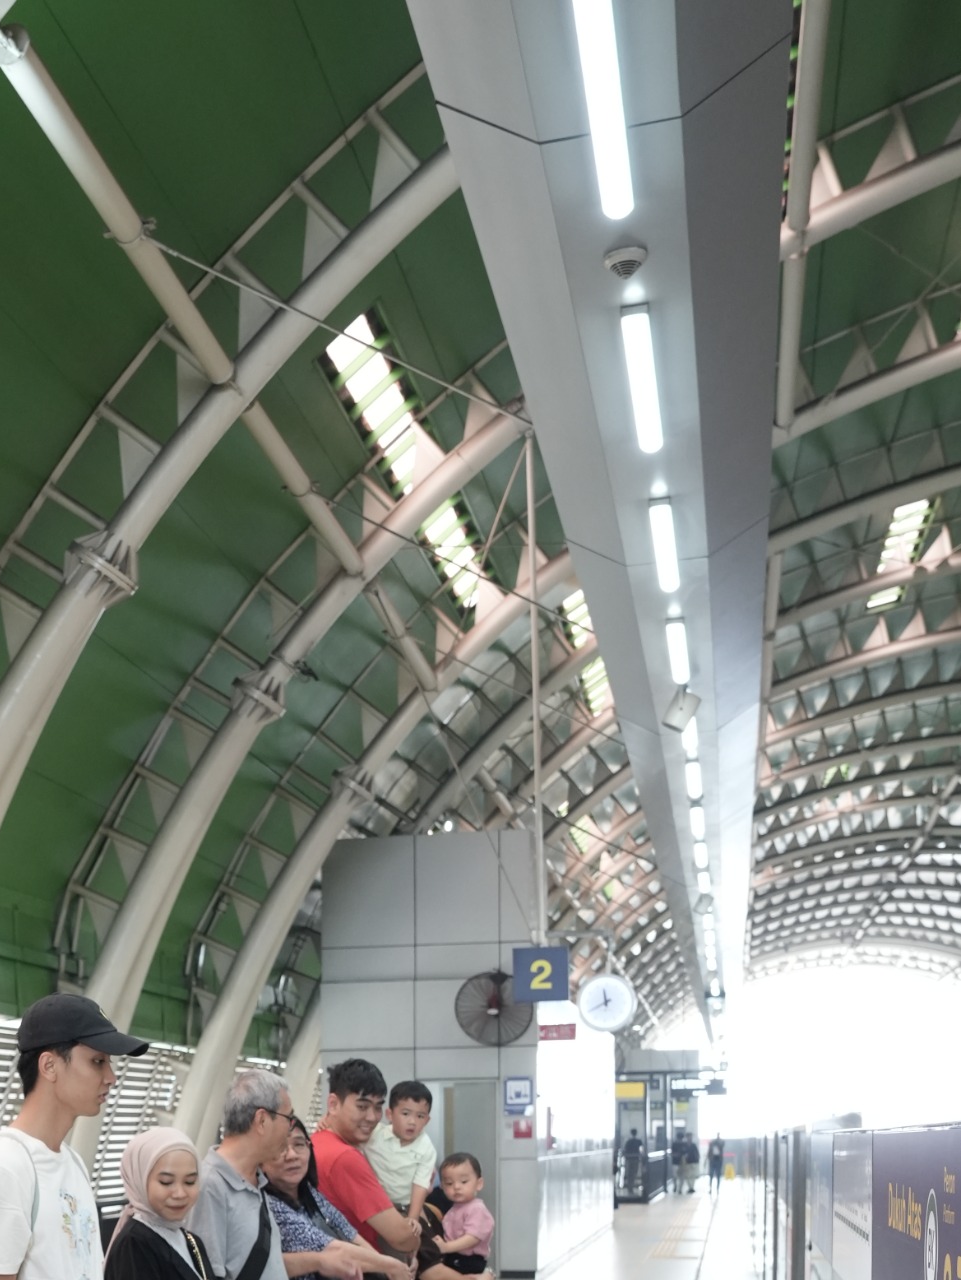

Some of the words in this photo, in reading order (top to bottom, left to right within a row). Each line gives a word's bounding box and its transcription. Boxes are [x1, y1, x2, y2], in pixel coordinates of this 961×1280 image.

[530, 960, 552, 989] 2
[944, 1166, 956, 1194] Peron
[888, 1182, 906, 1233] Dukuh
[906, 1187, 922, 1241] Atas
